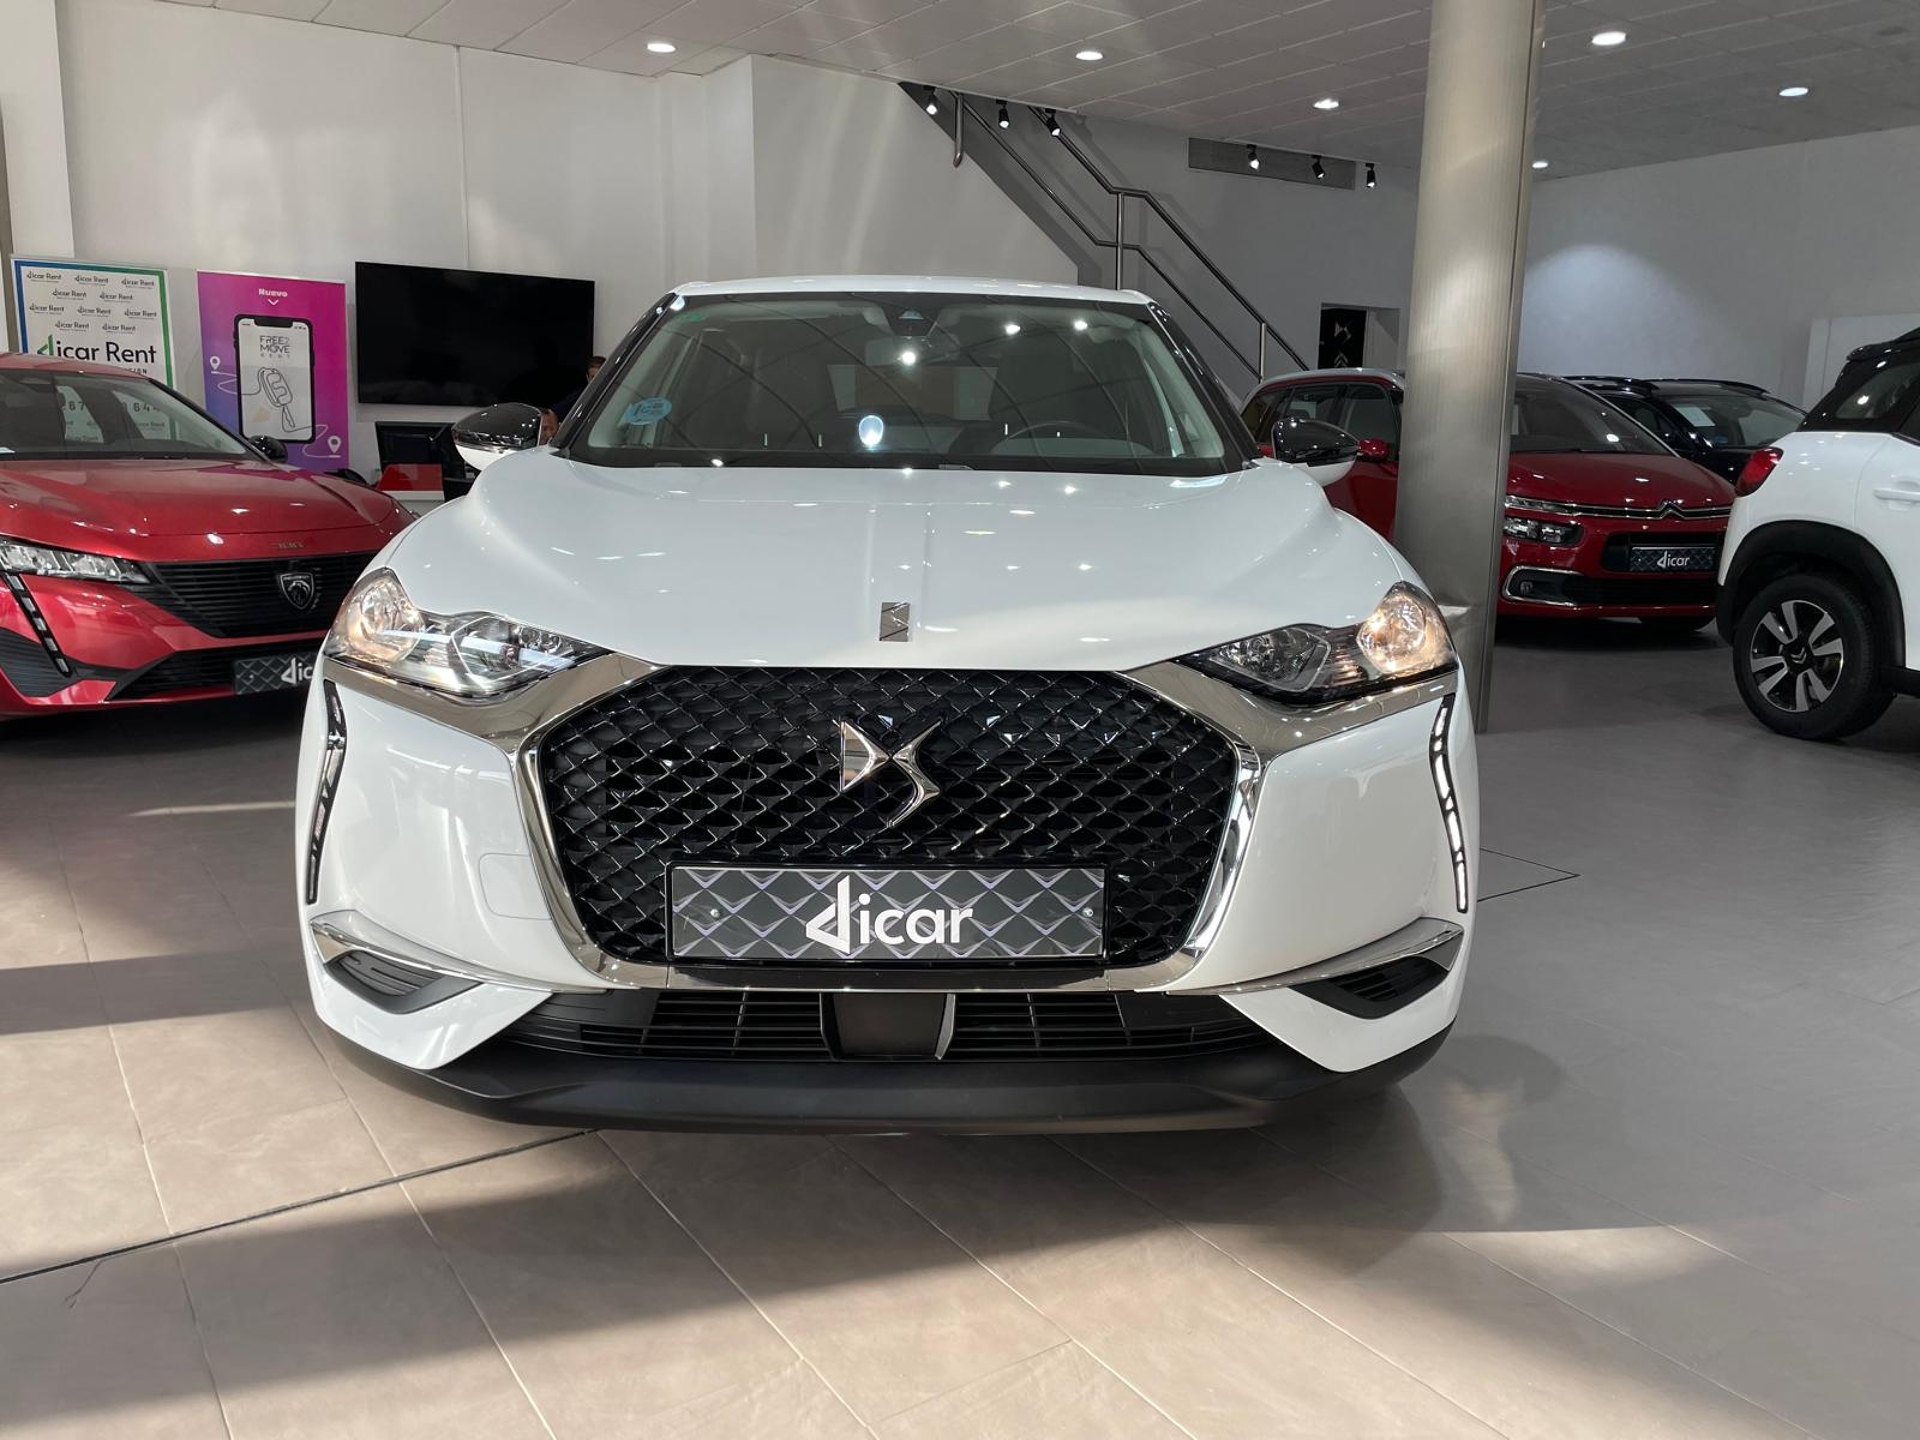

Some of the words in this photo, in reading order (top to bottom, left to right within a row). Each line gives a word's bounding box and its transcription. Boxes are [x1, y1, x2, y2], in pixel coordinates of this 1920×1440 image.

[258, 288, 288, 297] Nuevo
[105, 341, 157, 363] Rent
[260, 344, 290, 353] MOVE
[281, 657, 314, 684] dic
[805, 874, 973, 954] dicar
